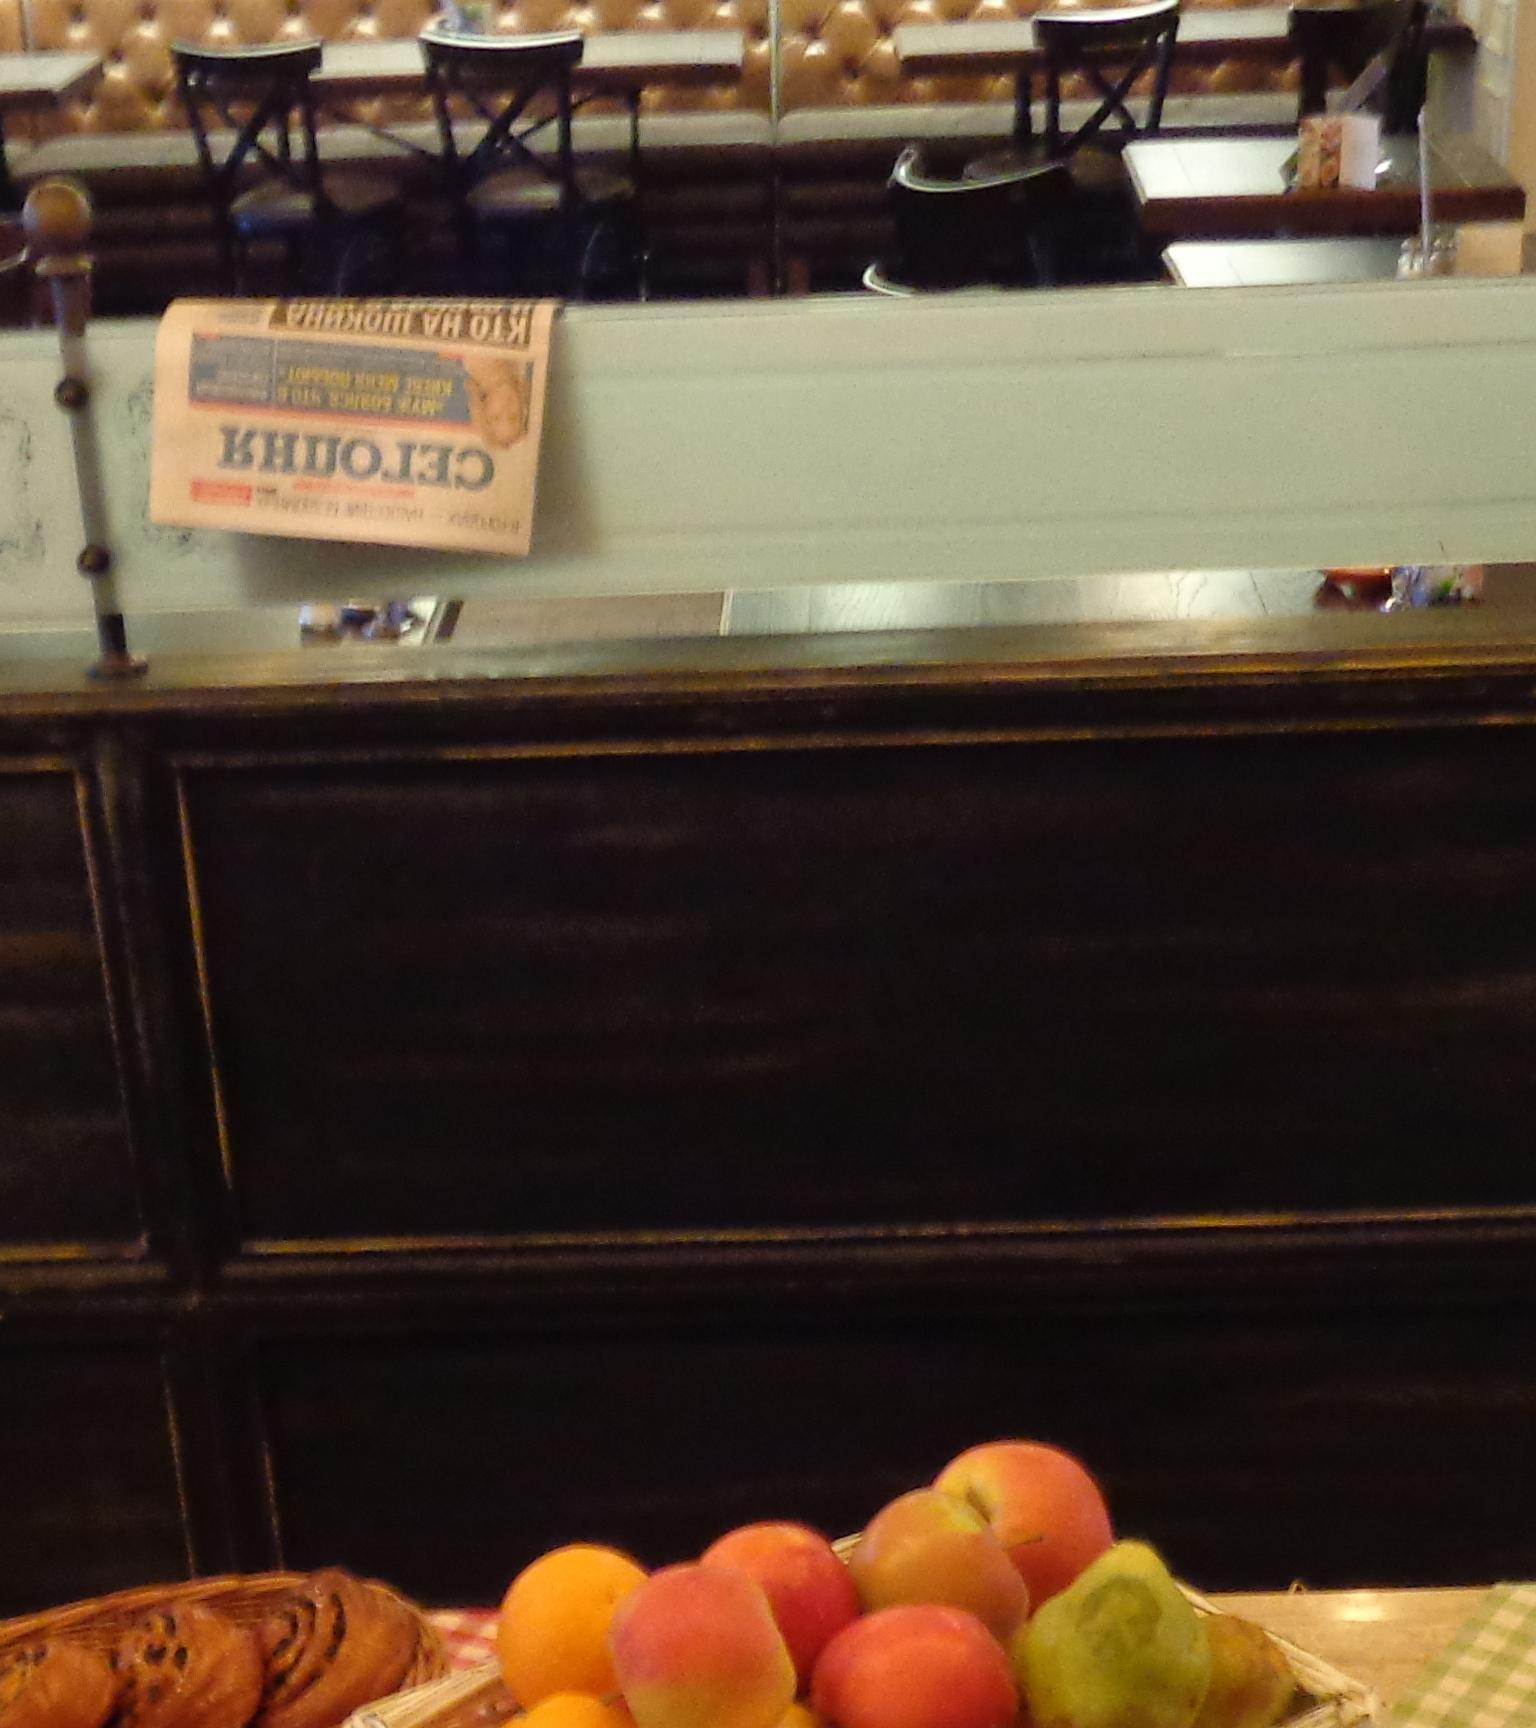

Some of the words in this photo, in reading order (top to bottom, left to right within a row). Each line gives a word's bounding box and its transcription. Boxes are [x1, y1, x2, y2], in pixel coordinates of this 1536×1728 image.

[423, 309, 461, 340] НА
[469, 312, 527, 346] КТО
[217, 424, 496, 493] СЕГОДНЯ
